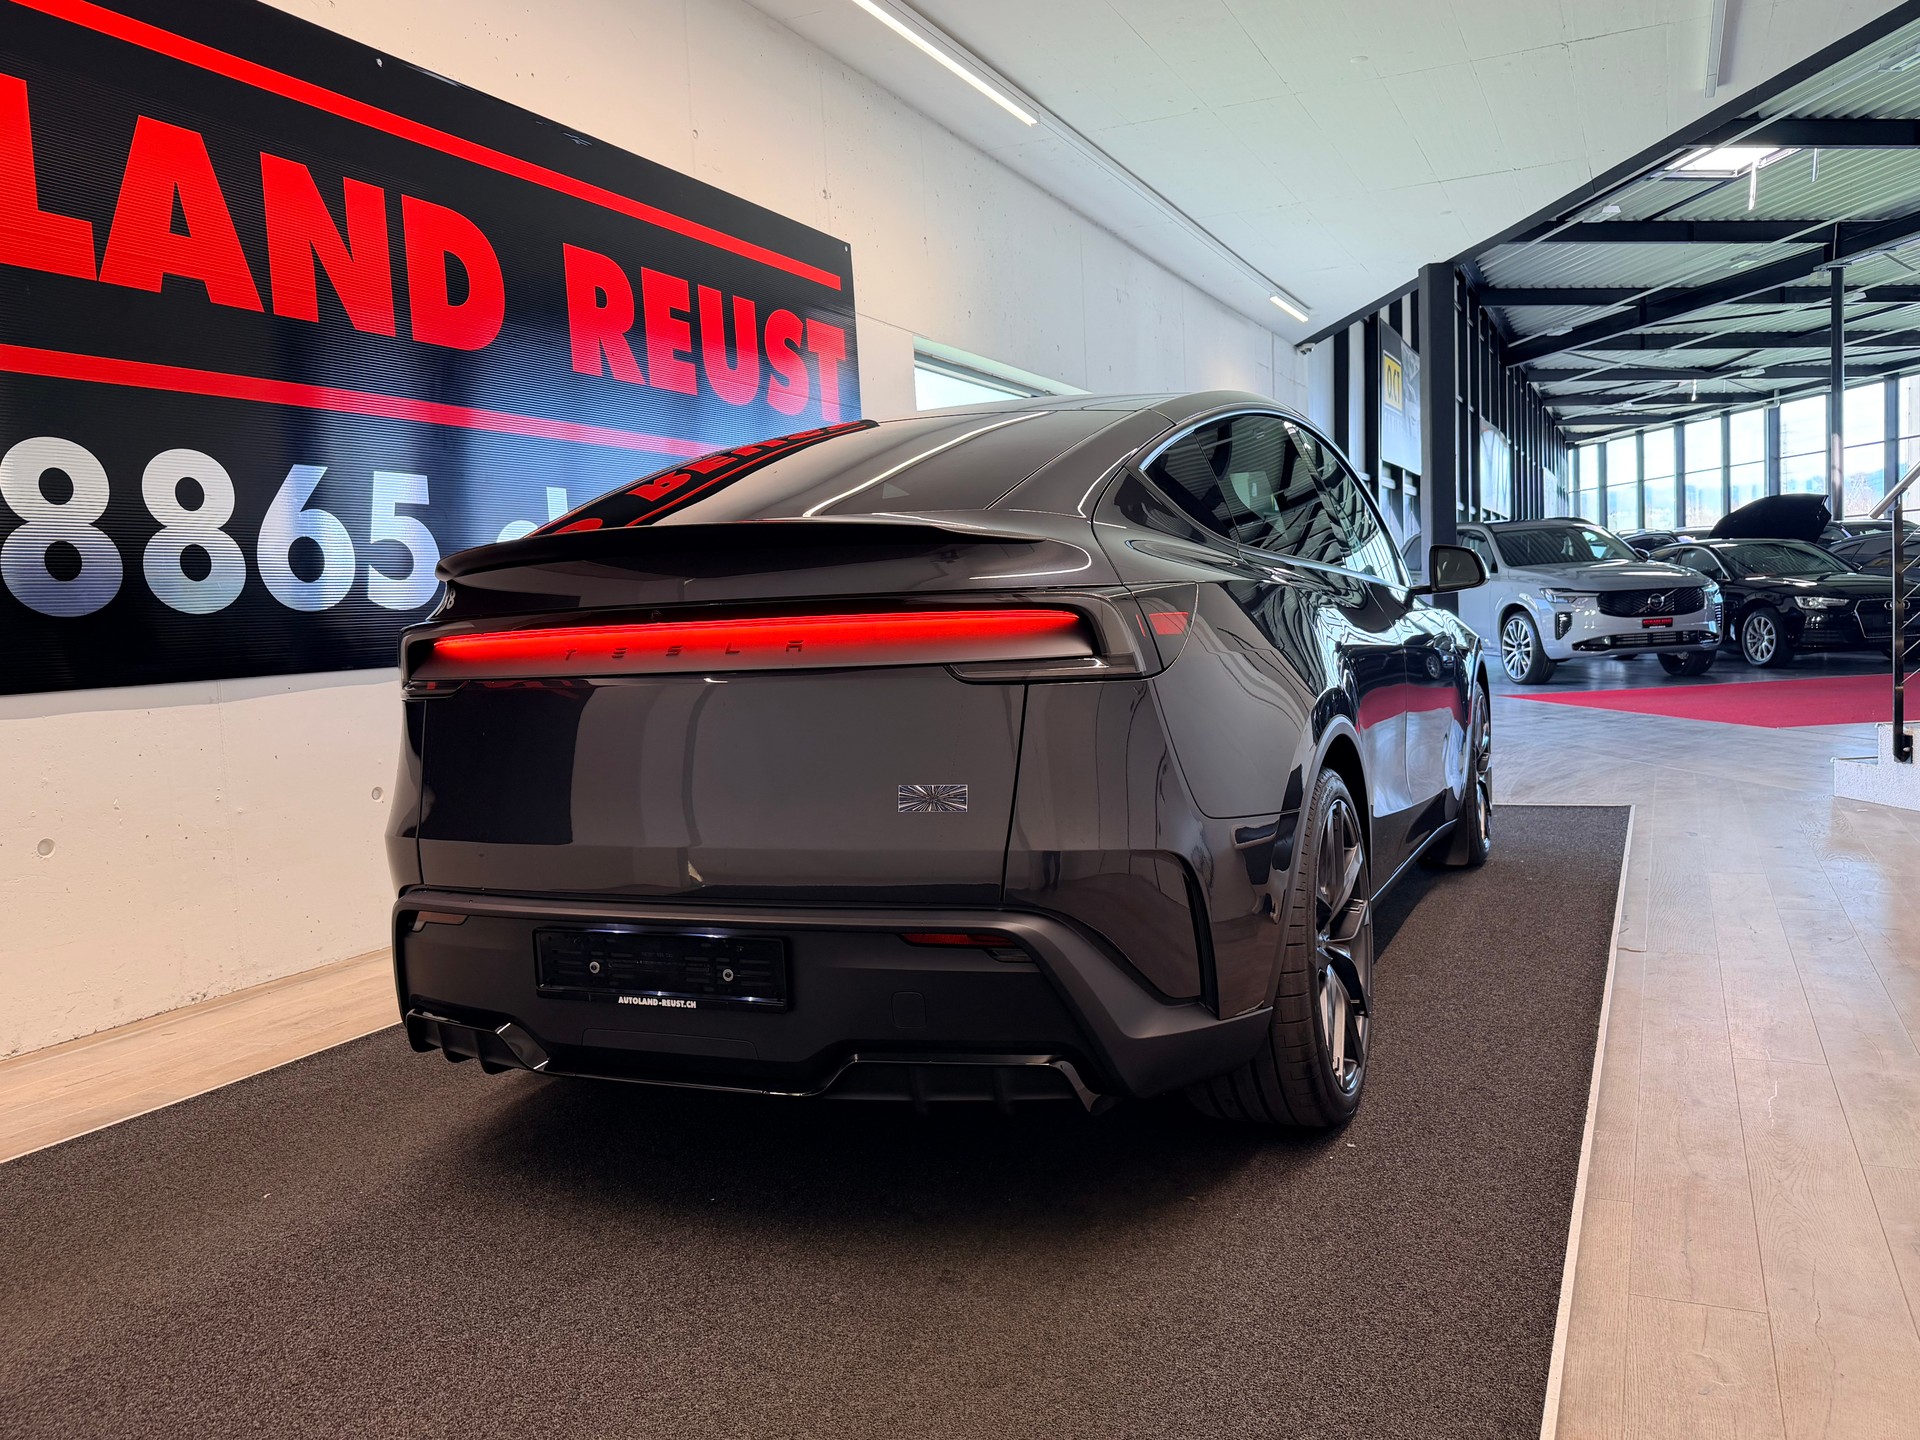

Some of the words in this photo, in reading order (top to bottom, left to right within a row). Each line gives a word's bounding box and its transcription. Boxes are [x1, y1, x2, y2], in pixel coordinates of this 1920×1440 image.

[563, 242, 847, 424] REUST
[0, 436, 441, 618] 8865
[565, 639, 804, 661] TESLA
